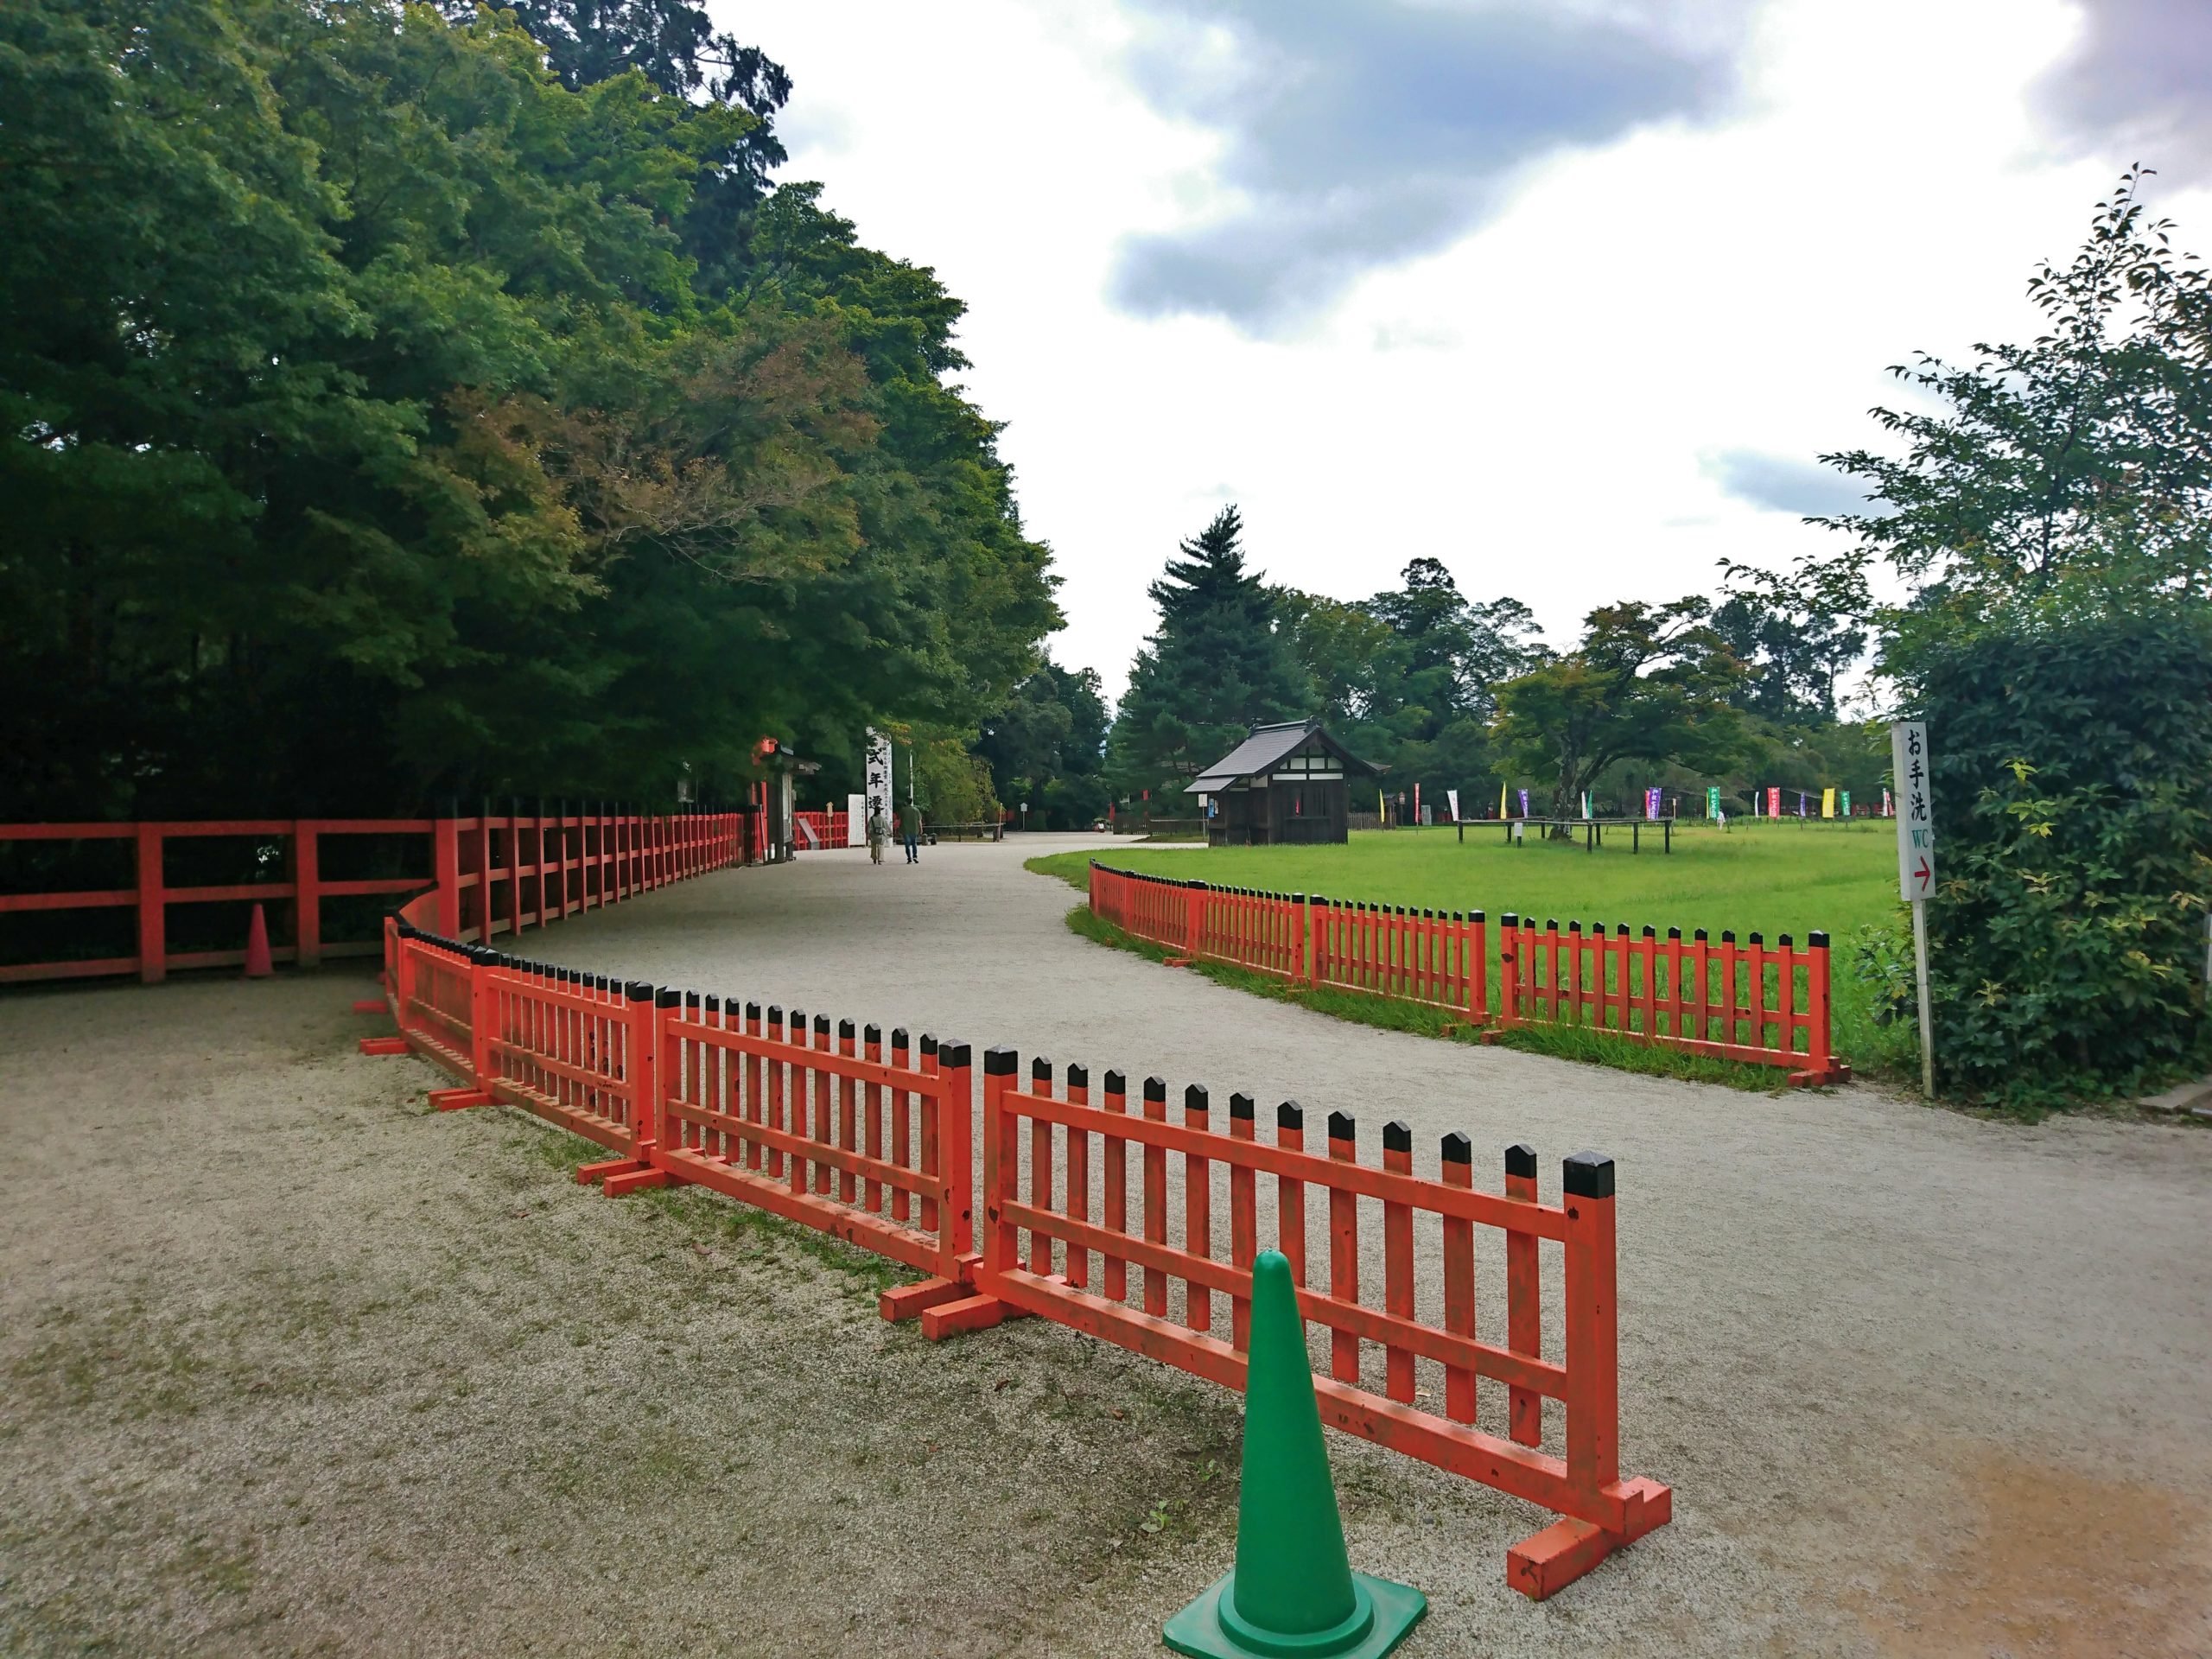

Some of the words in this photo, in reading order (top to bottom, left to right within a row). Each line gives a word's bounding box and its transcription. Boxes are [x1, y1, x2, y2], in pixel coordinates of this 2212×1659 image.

[1908, 728, 1927, 822] お手洗
[1911, 829, 1929, 849] WC
